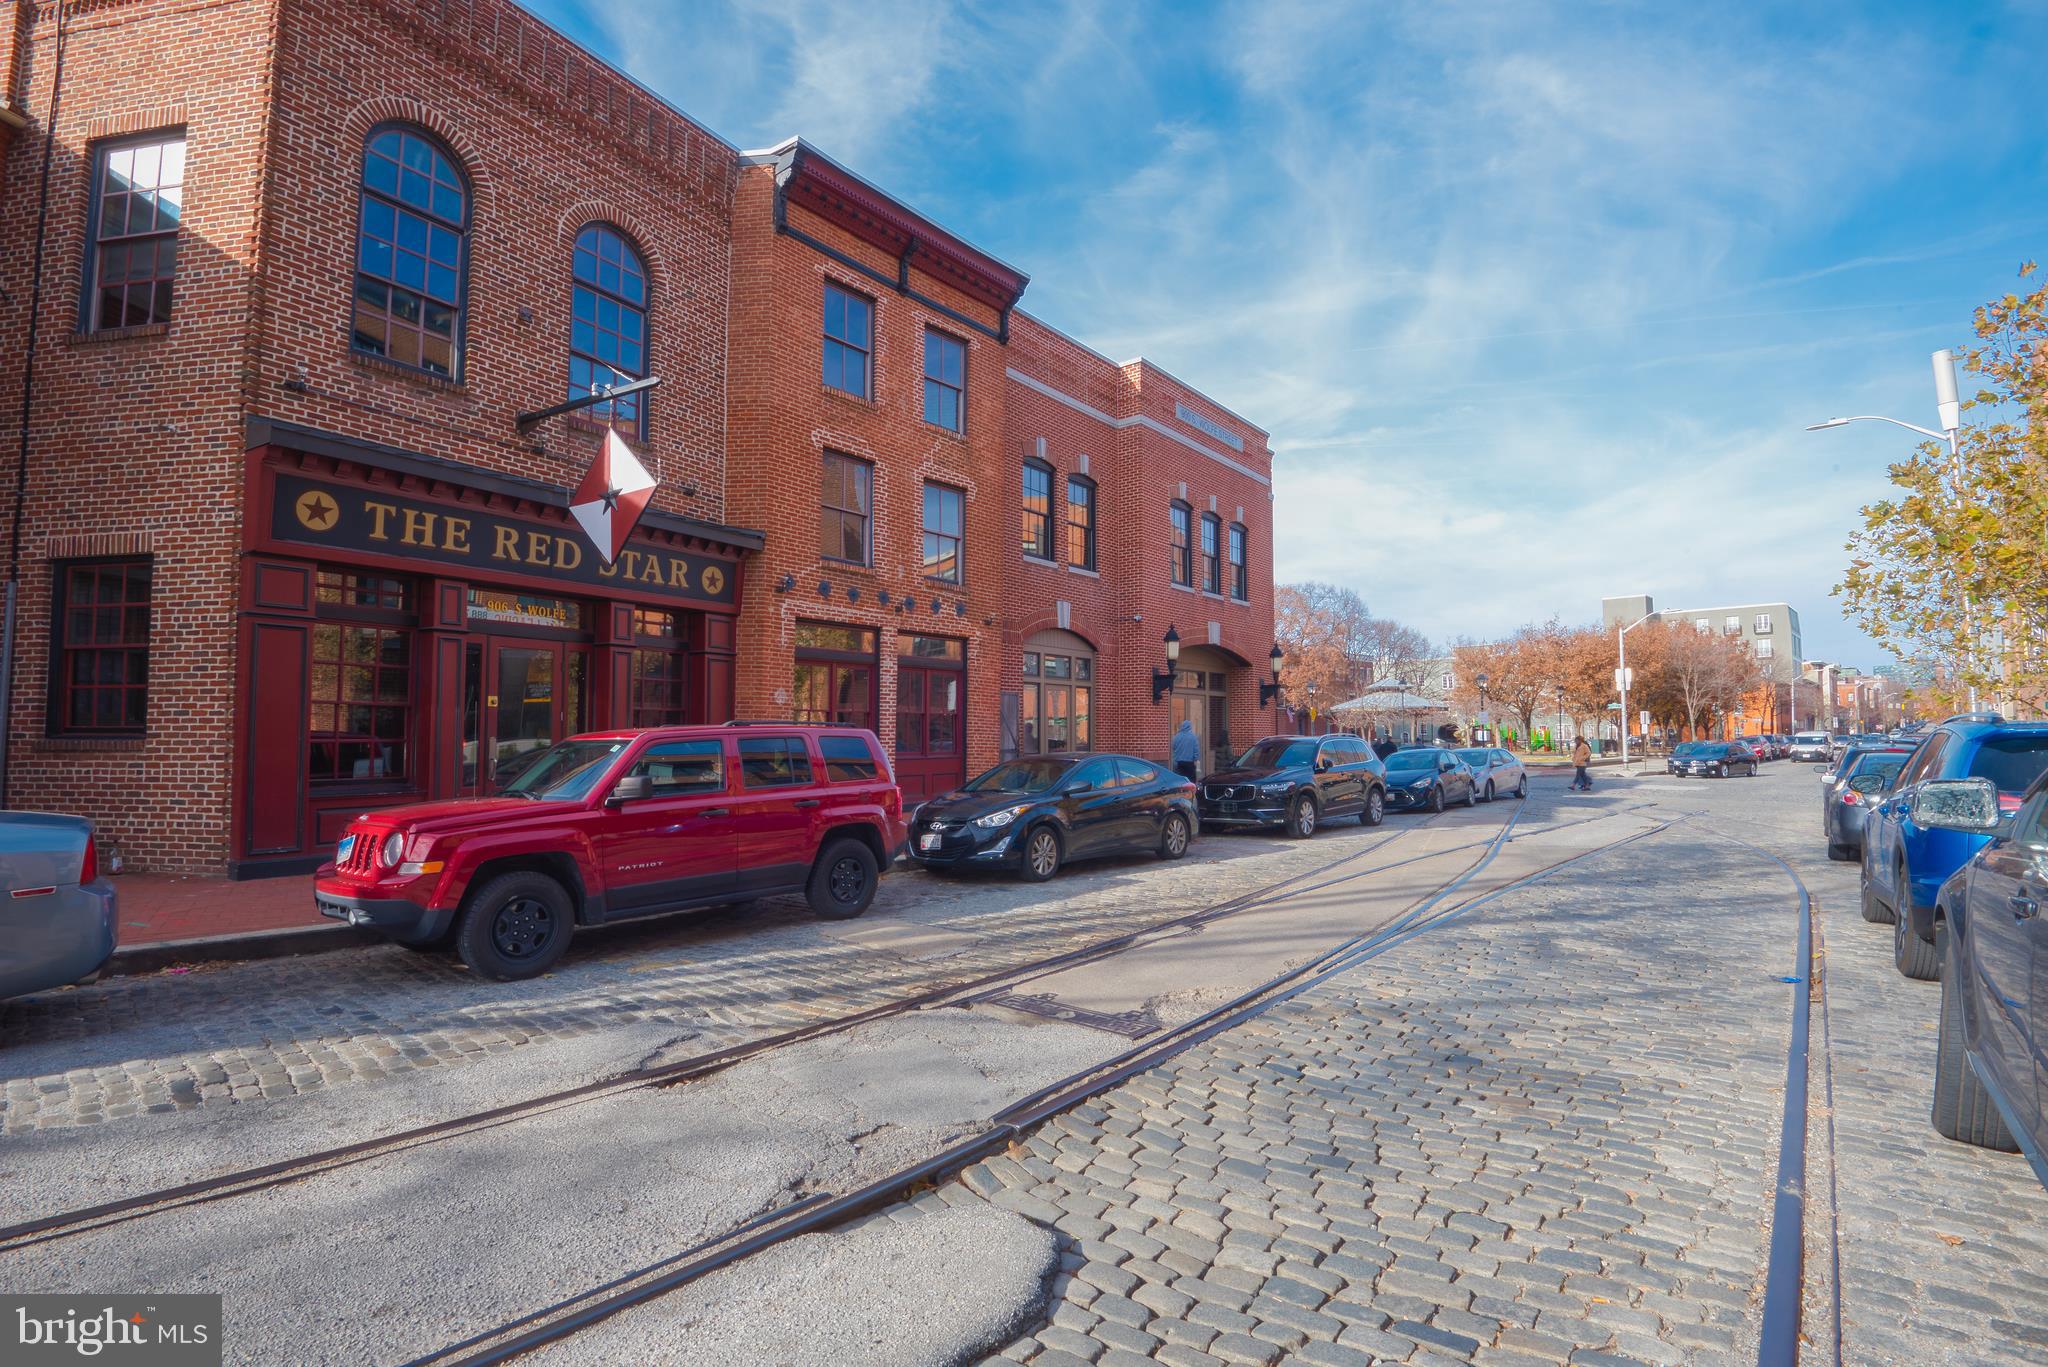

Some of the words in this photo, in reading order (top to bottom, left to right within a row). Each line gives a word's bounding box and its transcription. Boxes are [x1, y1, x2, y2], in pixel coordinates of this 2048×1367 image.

[364, 501, 472, 553] THE
[491, 525, 582, 570] RED
[487, 600, 509, 613] 906
[515, 603, 523, 615] S
[527, 604, 567, 620] WOLFE
[618, 861, 664, 871] PATRIOT
